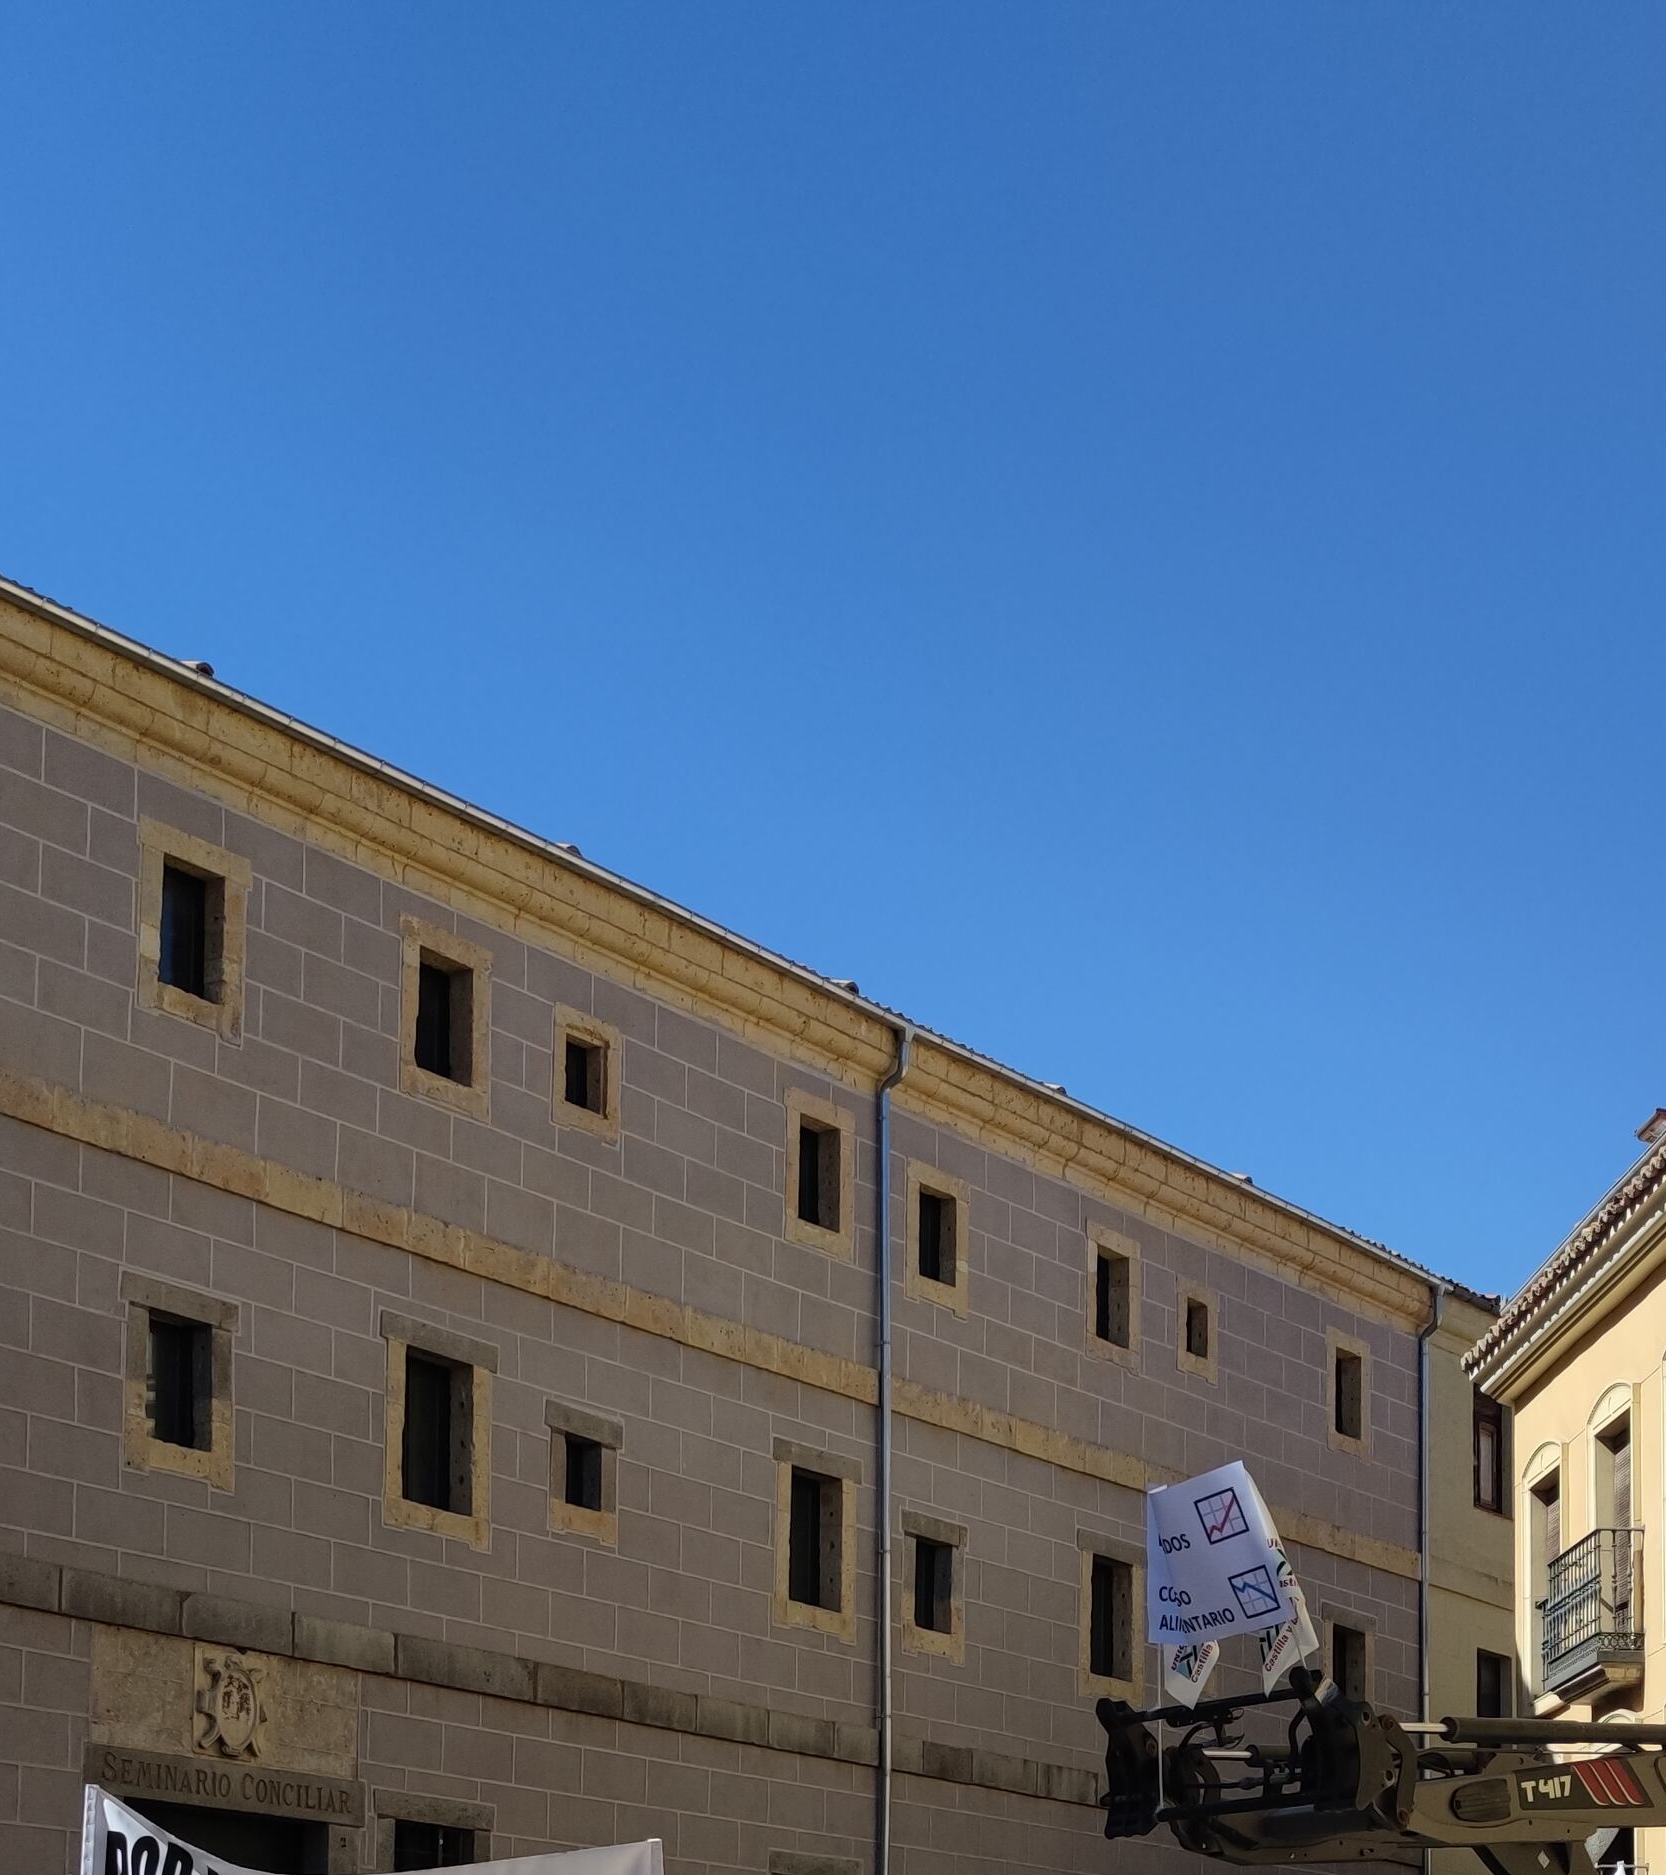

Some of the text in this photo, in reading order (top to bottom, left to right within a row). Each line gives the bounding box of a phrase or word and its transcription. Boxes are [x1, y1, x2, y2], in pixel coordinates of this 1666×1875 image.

[1191, 1643, 1214, 1683] Castilla
[1265, 1633, 1289, 1672] Castilla
[101, 1752, 351, 1814] SEMINARIO CONCILIAR
